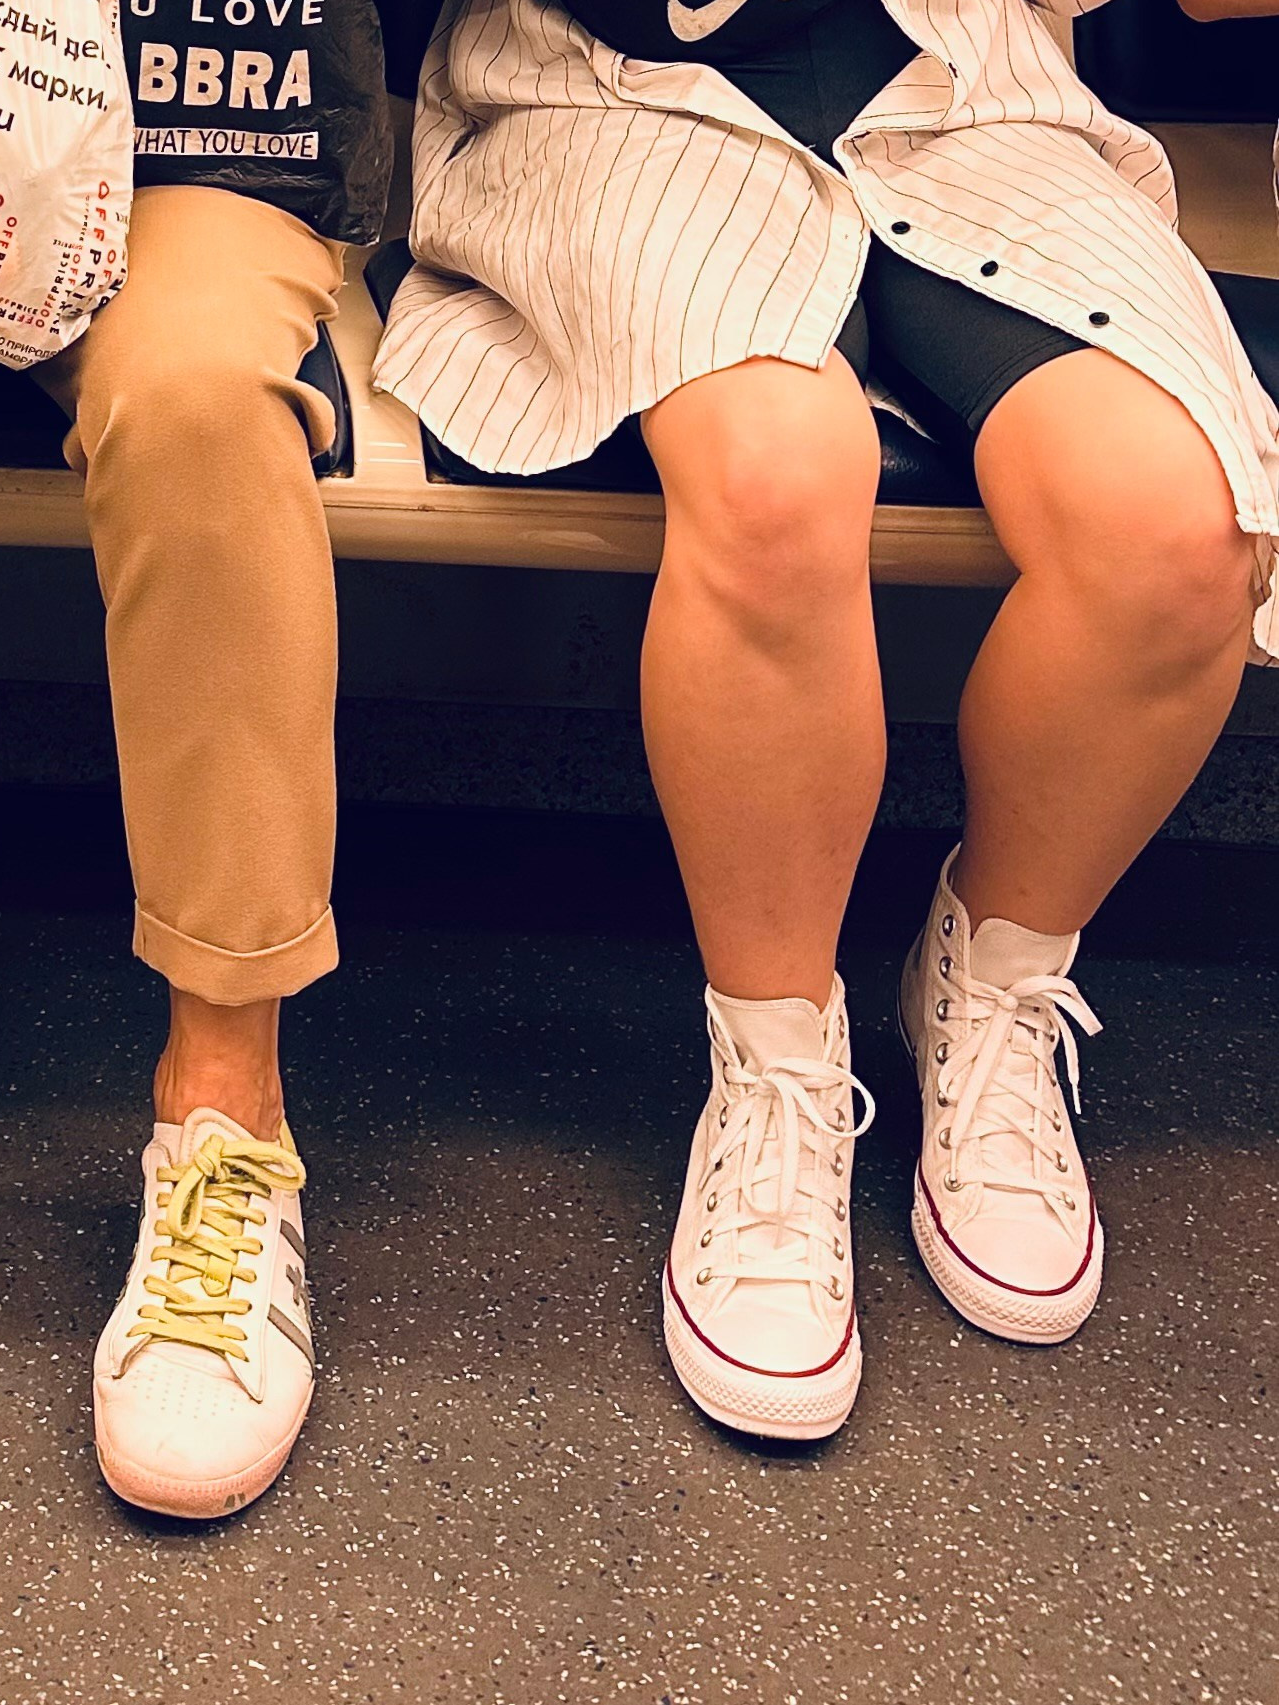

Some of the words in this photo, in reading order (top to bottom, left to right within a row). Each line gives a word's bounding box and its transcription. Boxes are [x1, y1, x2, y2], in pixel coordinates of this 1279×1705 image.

[64, 37, 105, 62] де
[138, 42, 312, 110] BBRA
[199, 130, 246, 154] YOU
[254, 134, 314, 159] LOVE
